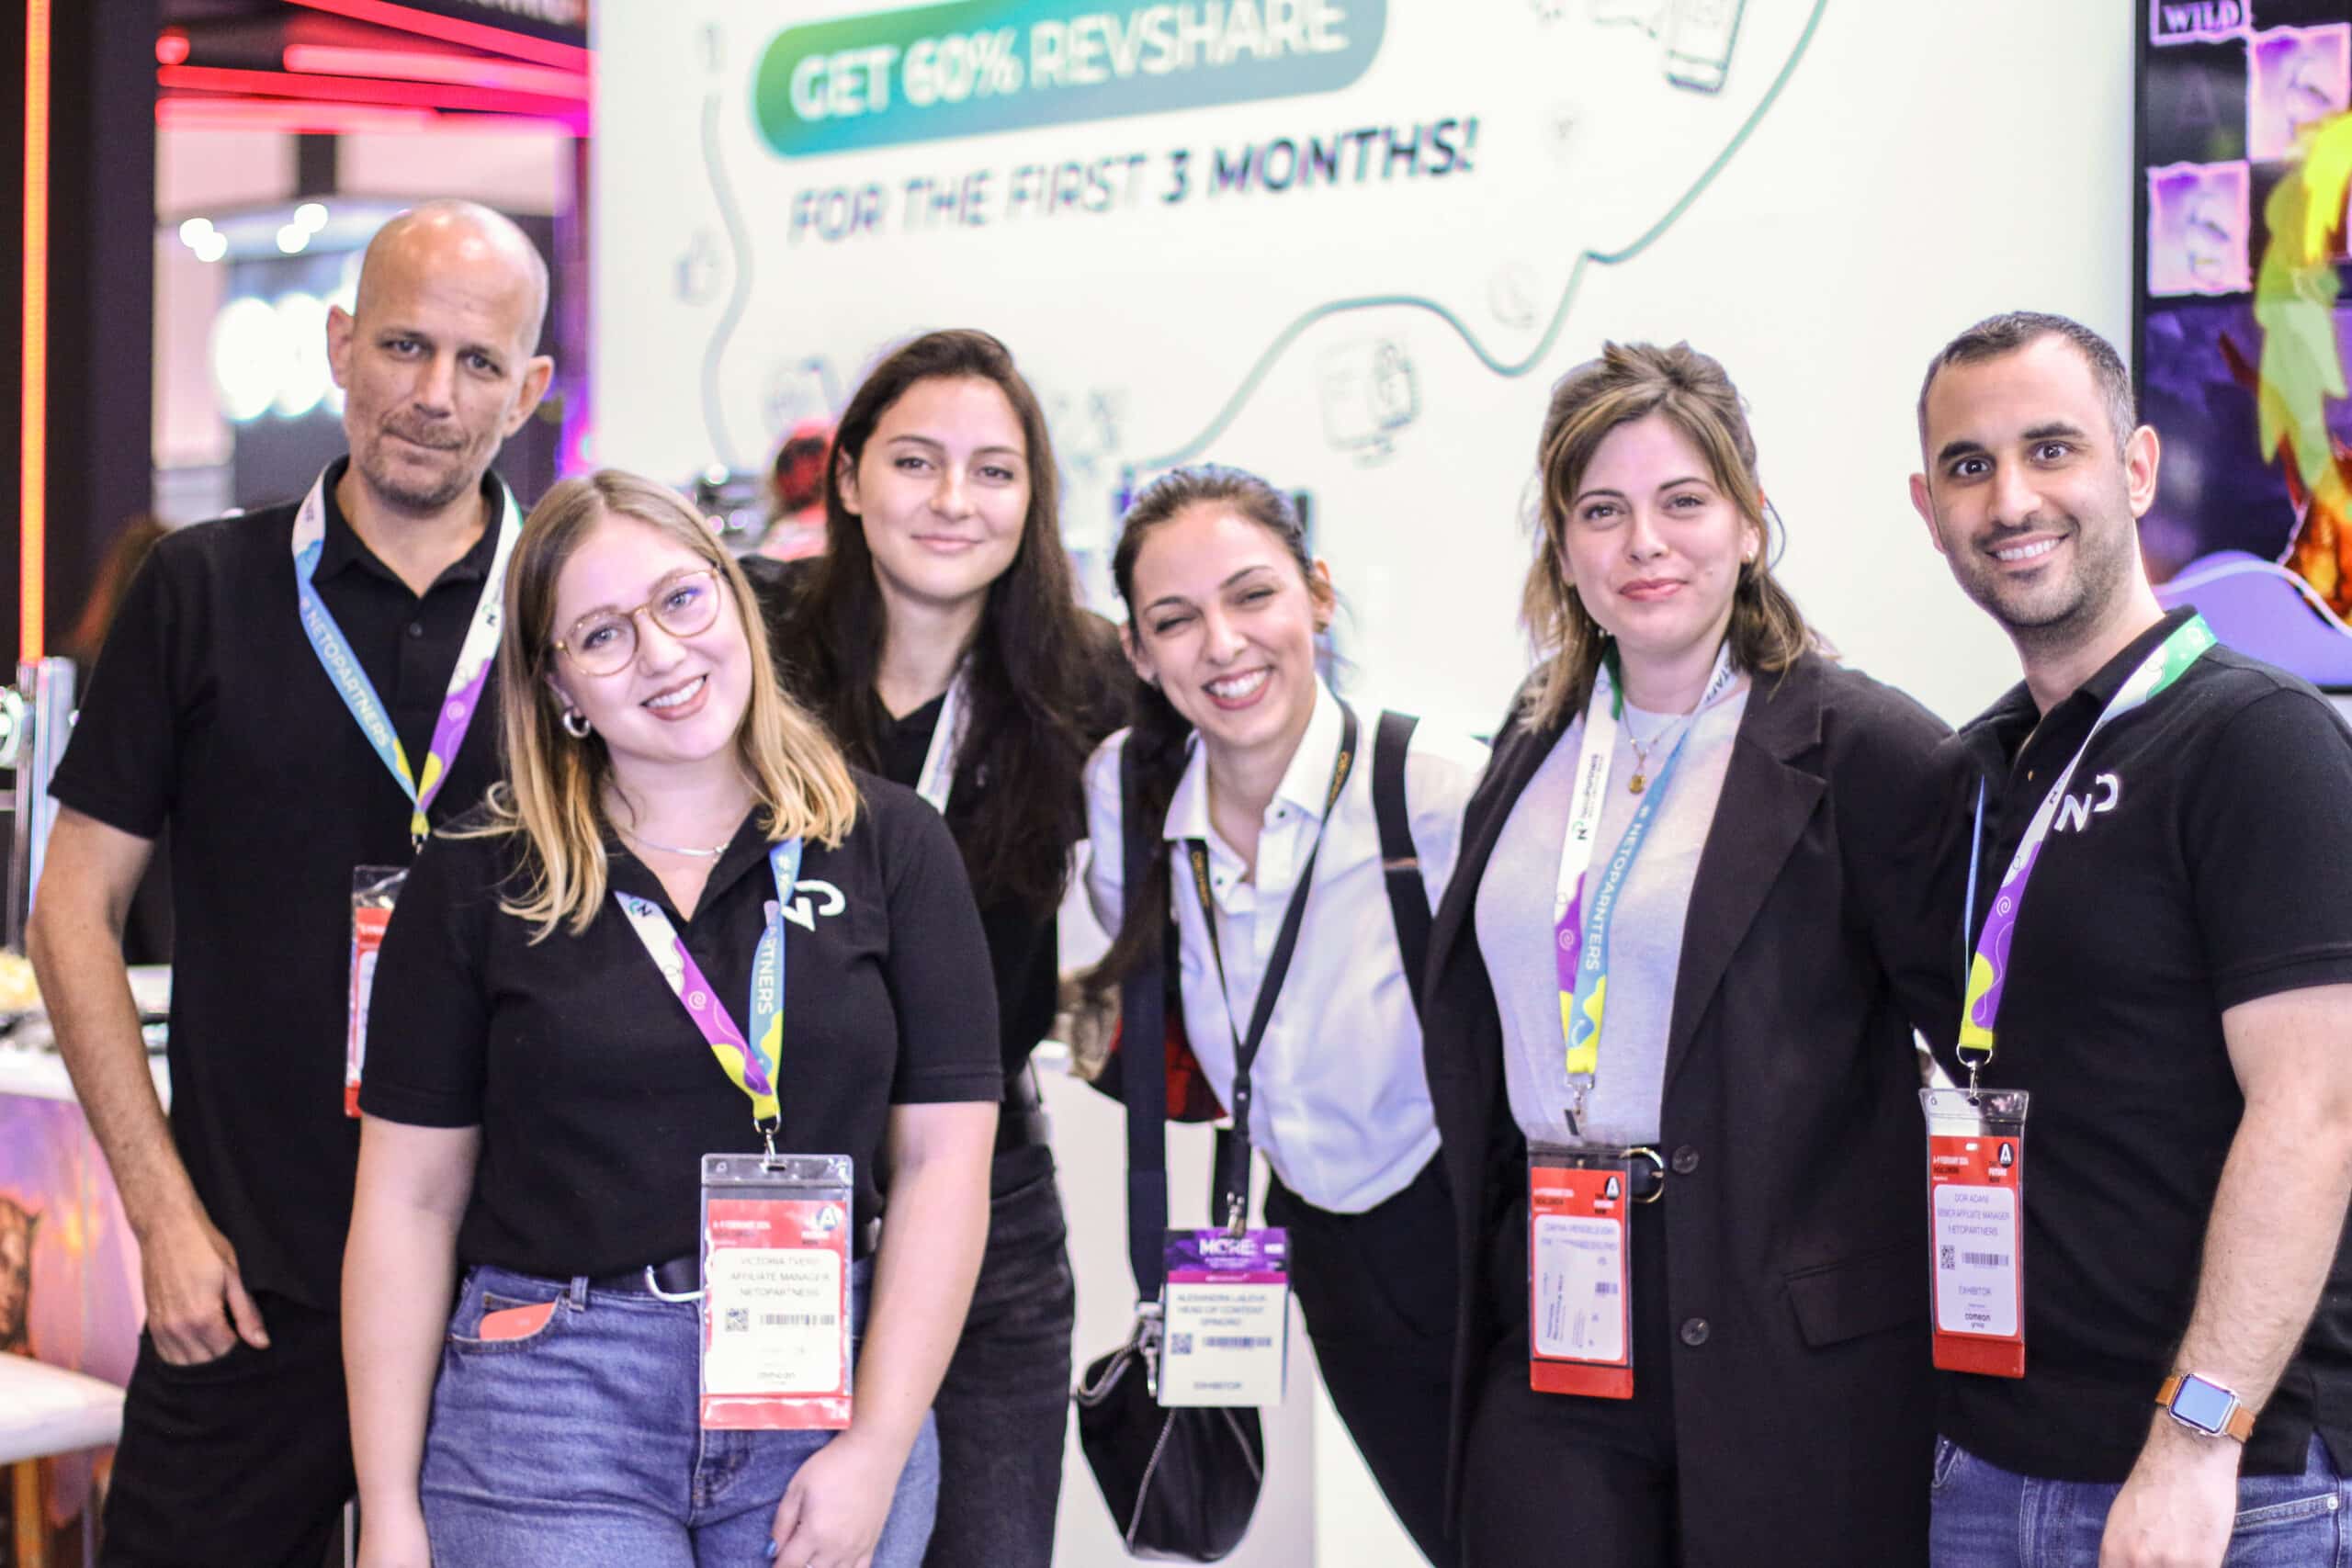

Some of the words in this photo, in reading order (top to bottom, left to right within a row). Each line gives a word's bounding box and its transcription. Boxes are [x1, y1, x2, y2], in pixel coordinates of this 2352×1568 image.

[790, 45, 899, 121] GET
[902, 28, 1024, 107] 60%
[1029, 0, 1350, 87] REVSHARE
[2161, 0, 2240, 32] WILD
[786, 184, 886, 248] FOR
[900, 167, 992, 230] THE
[1003, 153, 1148, 220] FIRST
[1161, 150, 1192, 204] 3
[1207, 116, 1479, 197] MONTHS!
[305, 606, 390, 748] NETOPARTNERS
